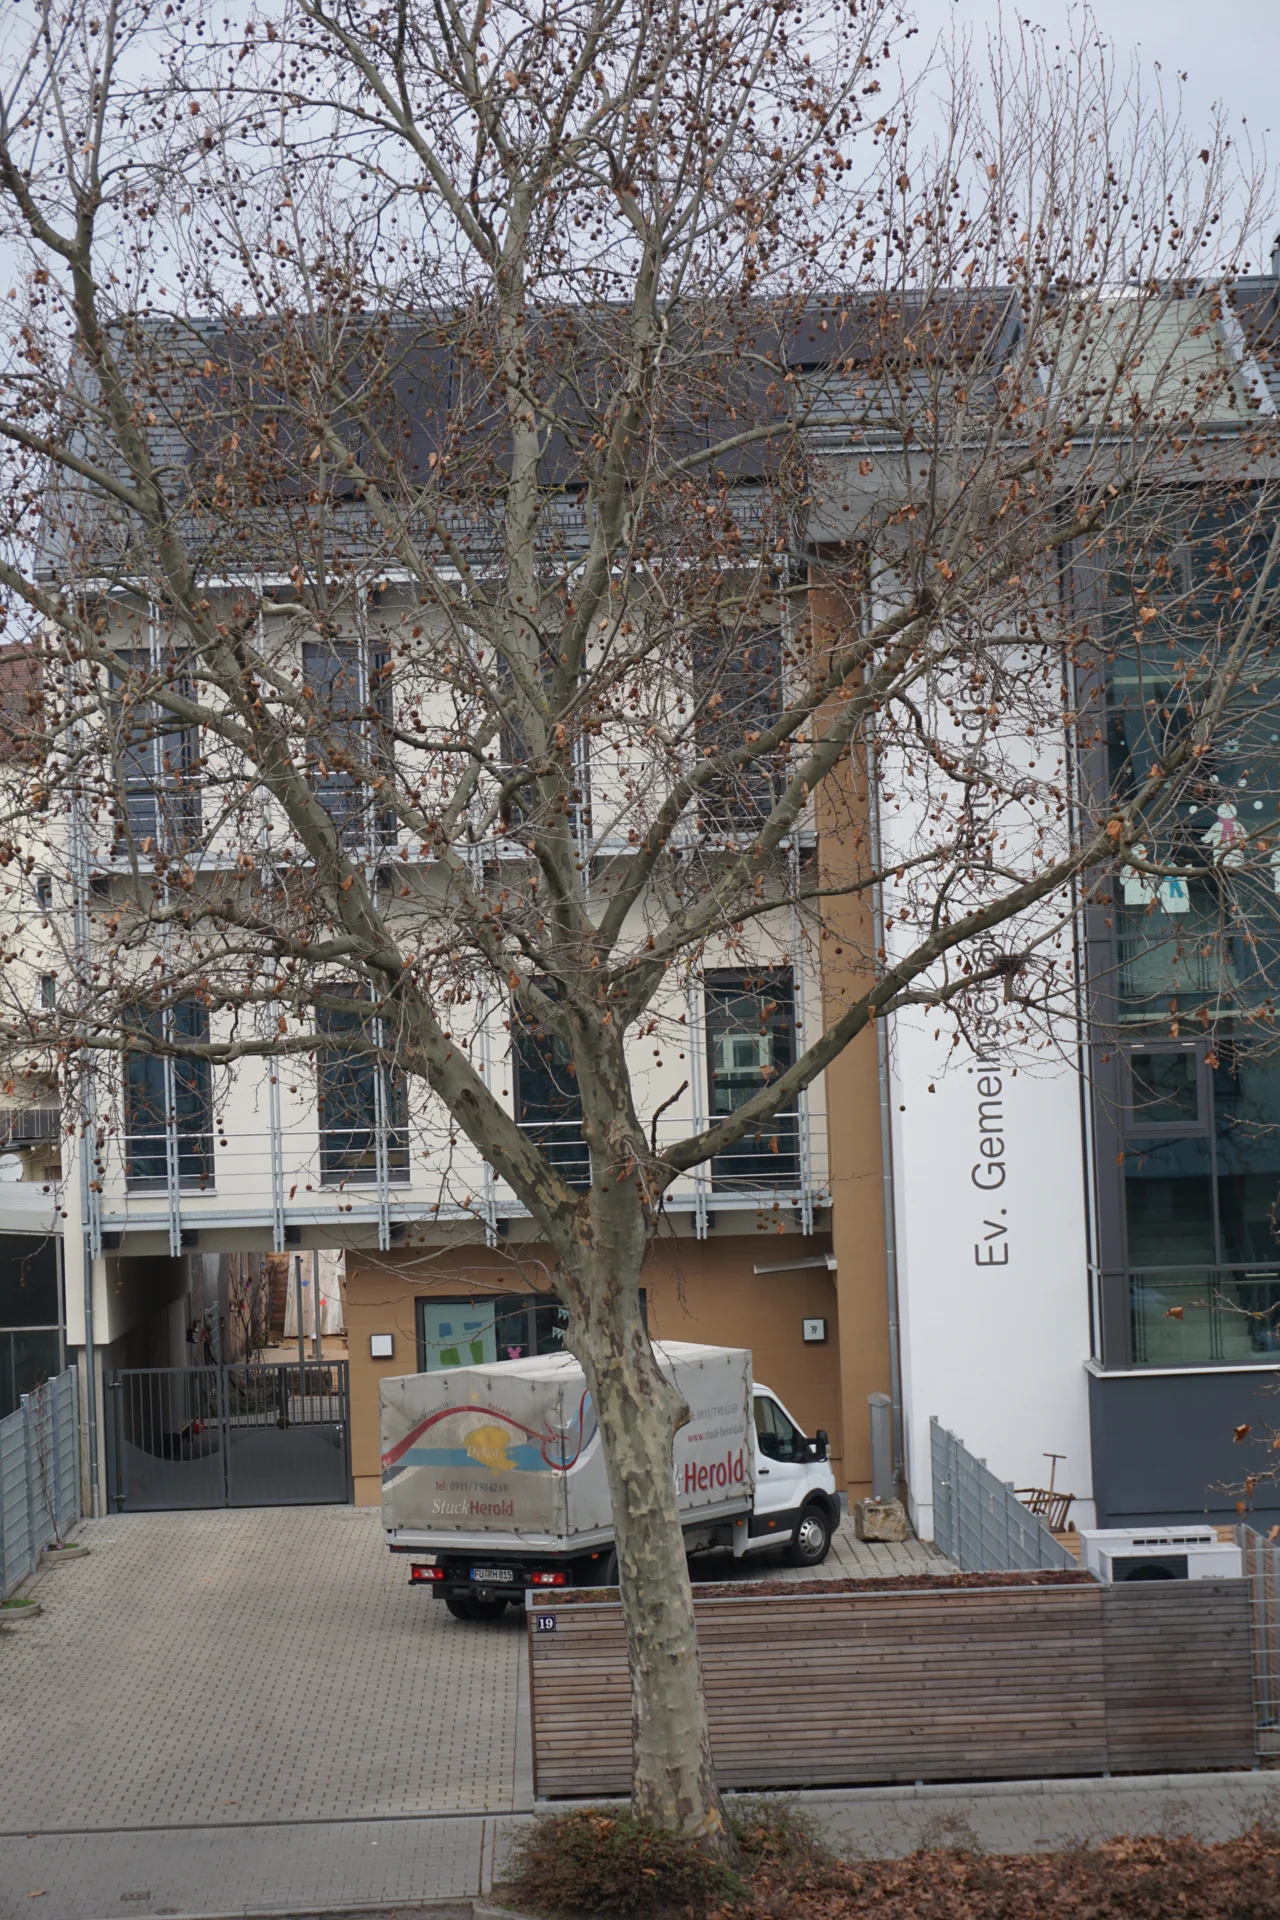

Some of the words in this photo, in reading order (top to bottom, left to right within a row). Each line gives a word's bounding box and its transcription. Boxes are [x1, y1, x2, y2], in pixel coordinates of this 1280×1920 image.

[974, 1208, 1009, 1267] Ev.
[810, 1325, 818, 1335] 19
[488, 1402, 513, 1418] Fassade
[466, 1445, 500, 1458] Dekor
[435, 1481, 448, 1492] Tel:
[539, 1617, 554, 1630] 19
